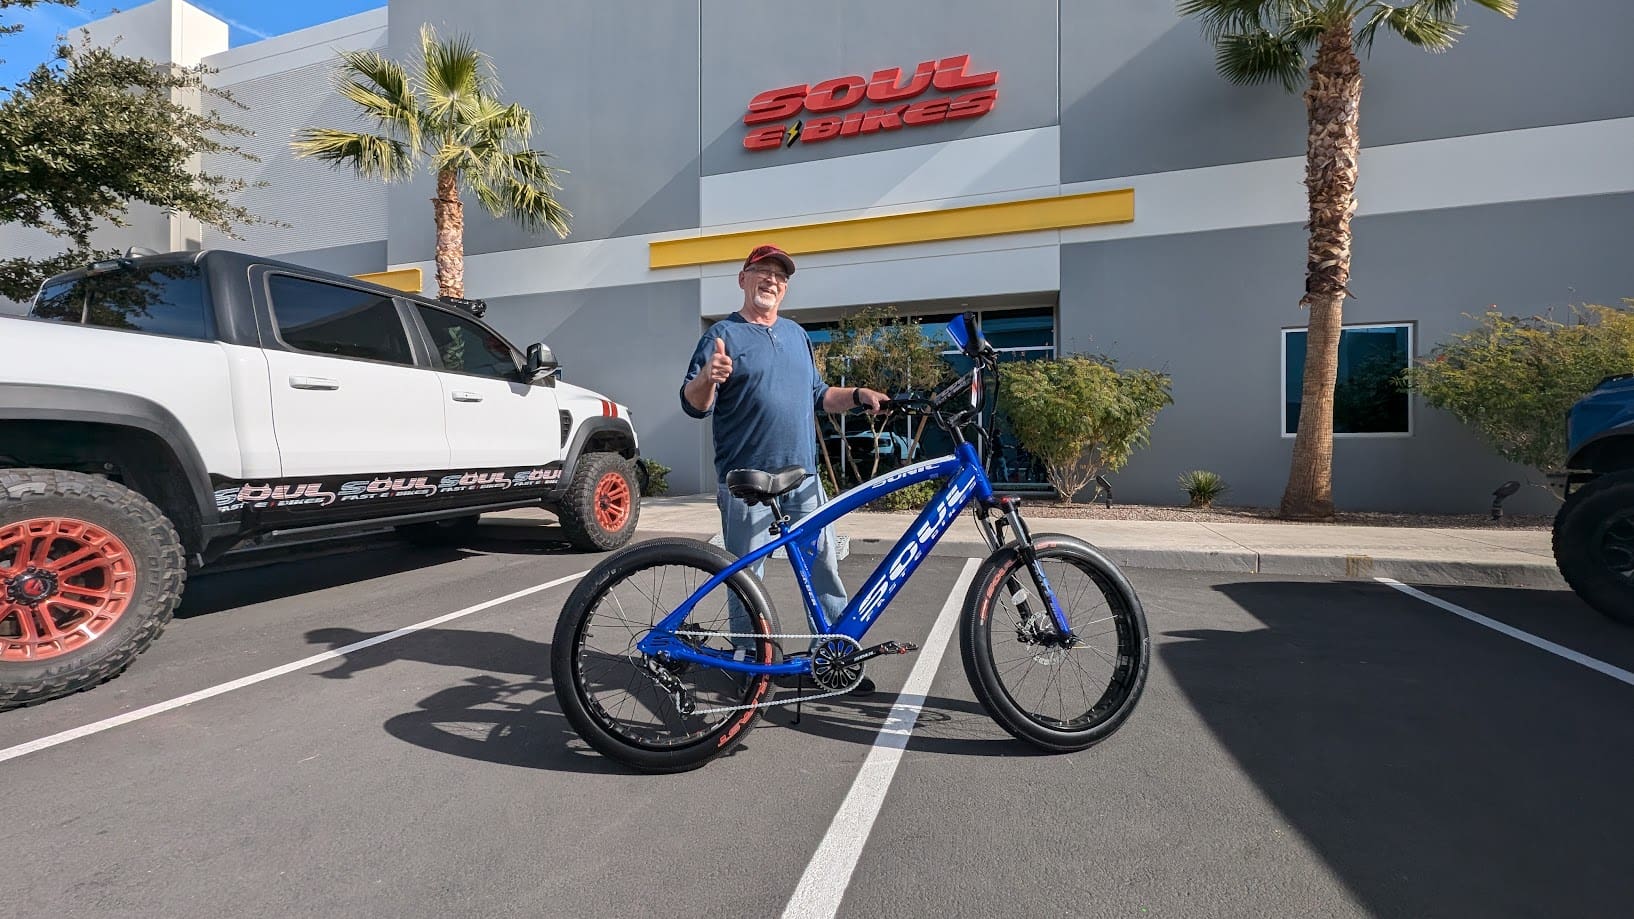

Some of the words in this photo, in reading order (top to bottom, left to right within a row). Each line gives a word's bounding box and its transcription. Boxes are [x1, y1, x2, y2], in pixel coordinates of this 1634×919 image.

[743, 55, 998, 125] SOUL
[438, 472, 512, 490] SOUL
[871, 463, 940, 489] SONIC
[214, 483, 336, 506] SOUL
[337, 477, 437, 497] SOUL
[340, 493, 378, 501] FAST
[439, 485, 467, 493] FAST
[858, 475, 976, 622] SOUL
